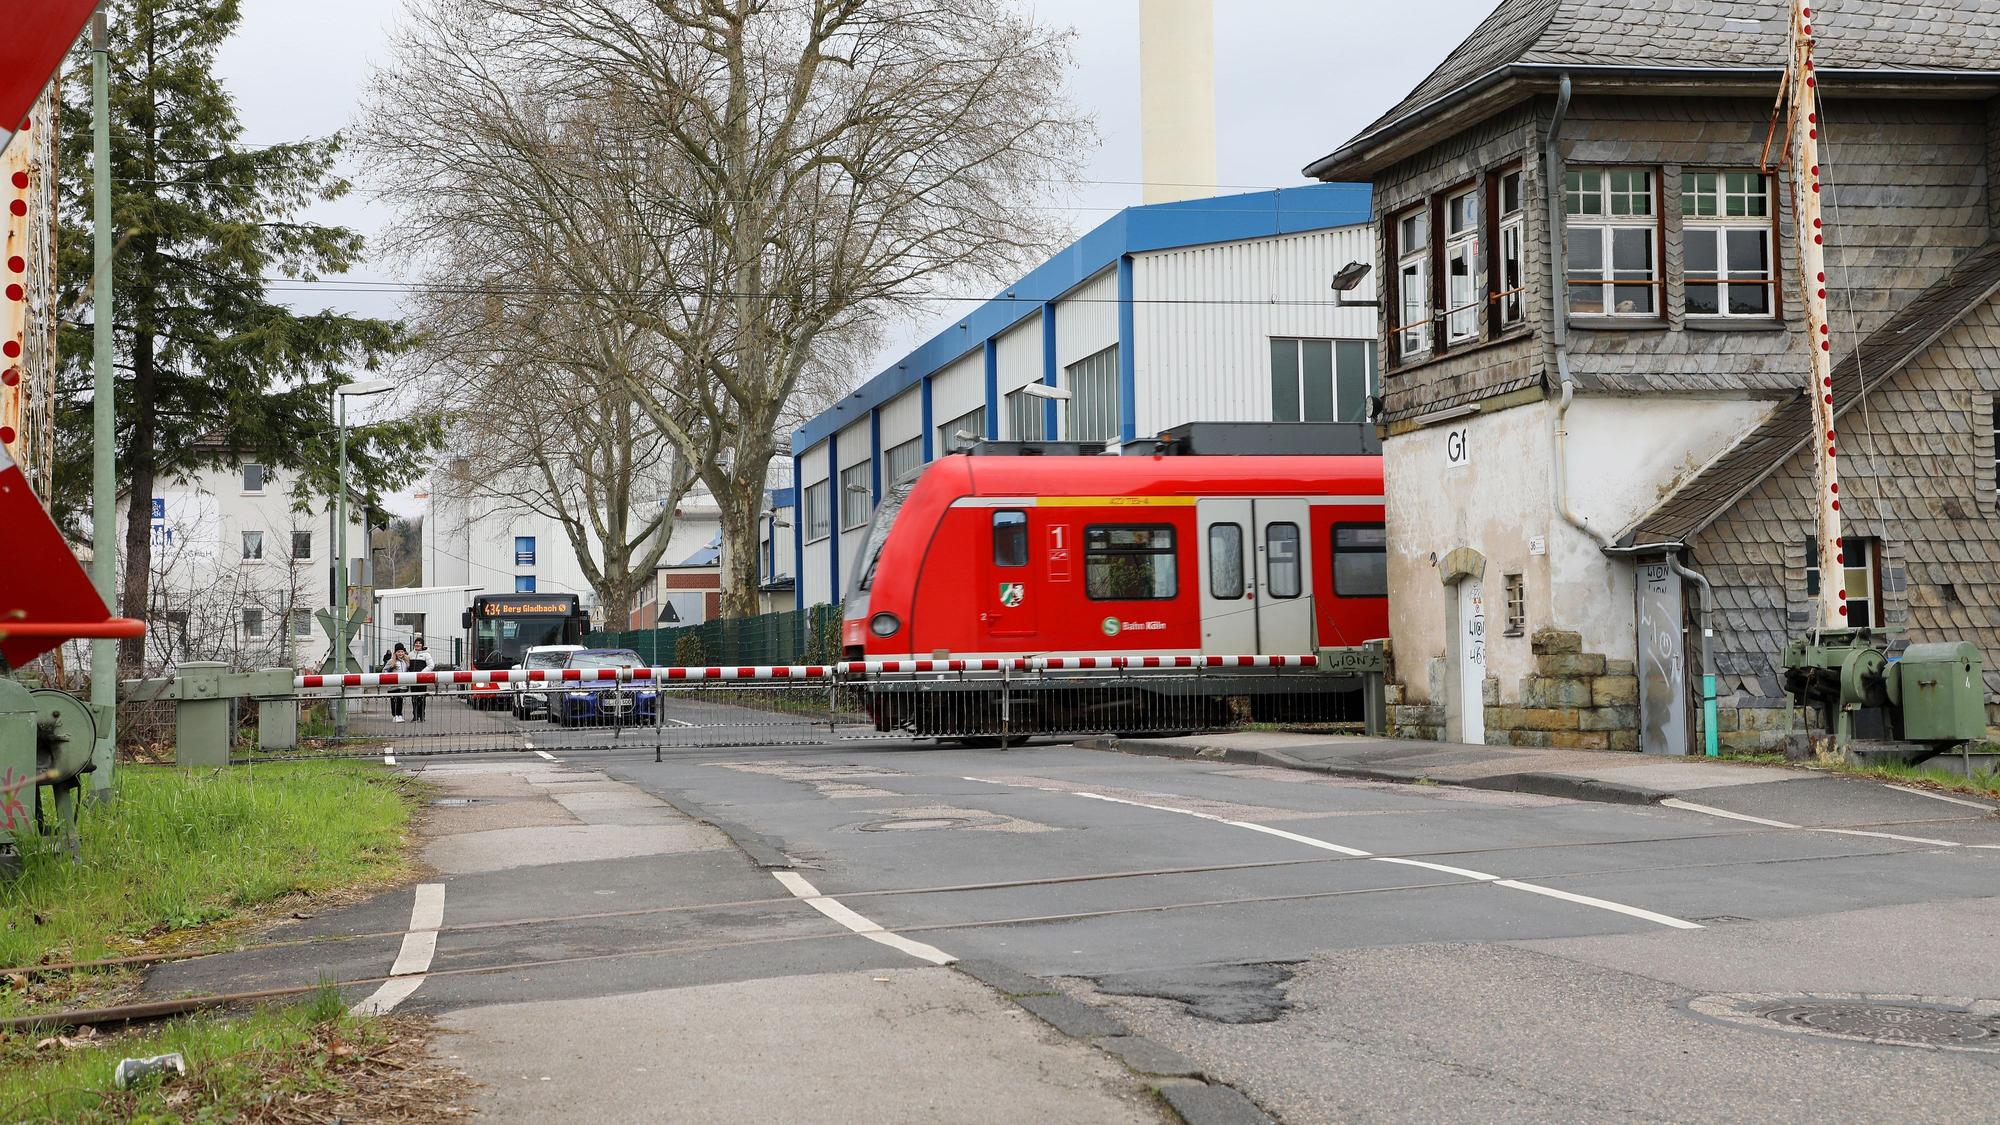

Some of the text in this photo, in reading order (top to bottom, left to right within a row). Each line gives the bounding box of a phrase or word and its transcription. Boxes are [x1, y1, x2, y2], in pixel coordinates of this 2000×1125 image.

[1448, 428, 1466, 462] Gf
[1050, 526, 1063, 549] 1
[484, 603, 500, 616] 434
[503, 605, 521, 613] Berg
[523, 604, 557, 613] Gladbach
[1122, 622, 1145, 631] Bahn
[1145, 621, 1167, 631] Köln
